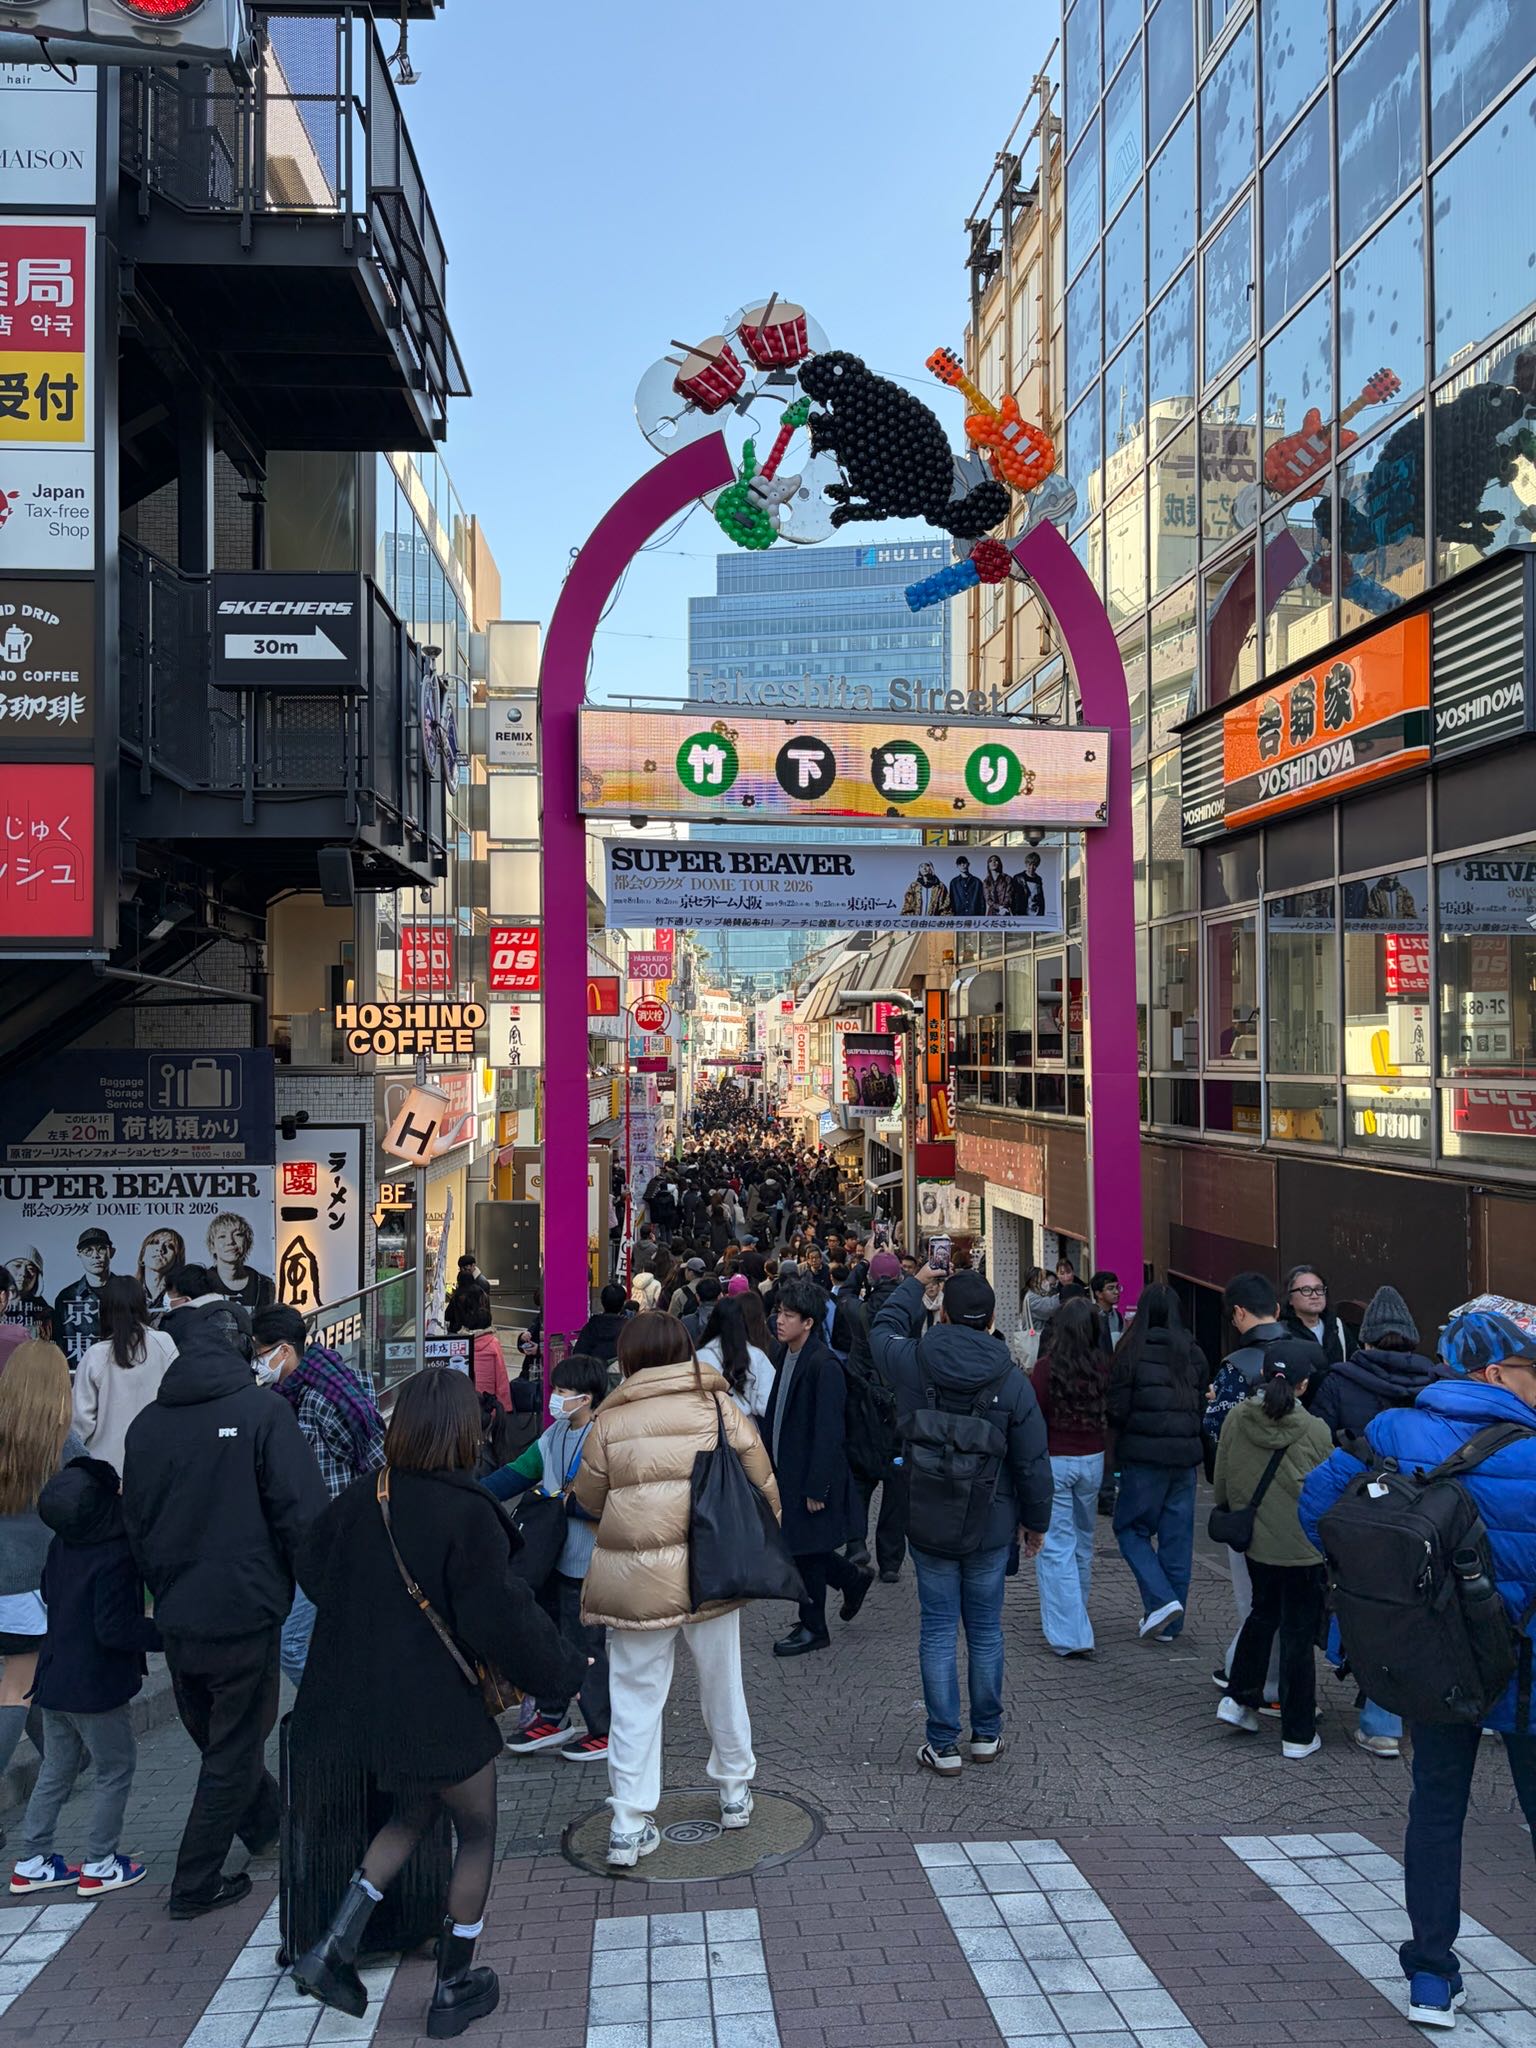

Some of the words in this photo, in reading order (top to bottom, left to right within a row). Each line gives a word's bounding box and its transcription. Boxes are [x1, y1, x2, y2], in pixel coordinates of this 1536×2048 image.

[7, 75, 32, 84] hair
[0, 258, 74, 308] 局
[30, 314, 73, 338] 약국
[32, 483, 85, 501] Japan
[24, 503, 90, 519] Tax-free
[48, 521, 90, 540] Shop
[878, 546, 942, 563] HULIC
[22, 605, 60, 625] DRIP
[216, 601, 354, 616] SKECHERS
[253, 639, 298, 655] 30m
[23, 671, 80, 682] COFFEE
[687, 665, 873, 711] Takeshita
[887, 677, 1004, 716] Street
[1257, 662, 1356, 762] 吉野家
[1435, 680, 1525, 734] YOSHINOYA
[495, 731, 533, 742] REMIX
[687, 743, 1008, 795] 竹下通り
[1257, 739, 1356, 799] YOSHINOYA
[6, 816, 72, 841] じゅく
[611, 847, 726, 874] SUPER
[729, 852, 855, 877] BEAVER
[614, 874, 687, 891] 都会のラクダ
[690, 878, 737, 892] DOME
[739, 879, 780, 893] TOUR
[783, 880, 813, 893] 2026
[679, 894, 763, 910] 京セラドーム大阪
[847, 896, 898, 912] 東京ドーム
[494, 932, 536, 945] クスリ
[492, 949, 538, 970] OS
[492, 974, 538, 986] ドラッグ
[632, 963, 668, 978] ¥300
[335, 1003, 487, 1030] HOSHINO
[637, 1009, 663, 1023] 消火栓
[835, 1020, 860, 1031] NOA
[348, 1030, 475, 1055] COFFEE
[797, 1033, 806, 1073] COFFEE
[100, 1077, 144, 1088] Baggage
[104, 1088, 144, 1099] Storage
[106, 1099, 144, 1109] Service
[48, 1130, 69, 1141] 左手
[72, 1125, 110, 1141] 20m
[121, 1116, 240, 1141] 荷物預かり
[396, 1111, 437, 1156] H
[10, 1146, 189, 1159] 原宿ツーリストインフォメーションセンター
[0, 1173, 108, 1201] UPER
[112, 1172, 260, 1199] BEAVER
[327, 1151, 347, 1231] ラーメン
[380, 1184, 407, 1203] BF
[21, 1201, 92, 1219] 都会のラクダ
[97, 1203, 141, 1216] DOME
[147, 1203, 185, 1216] TOUR
[188, 1202, 219, 1216] 2026
